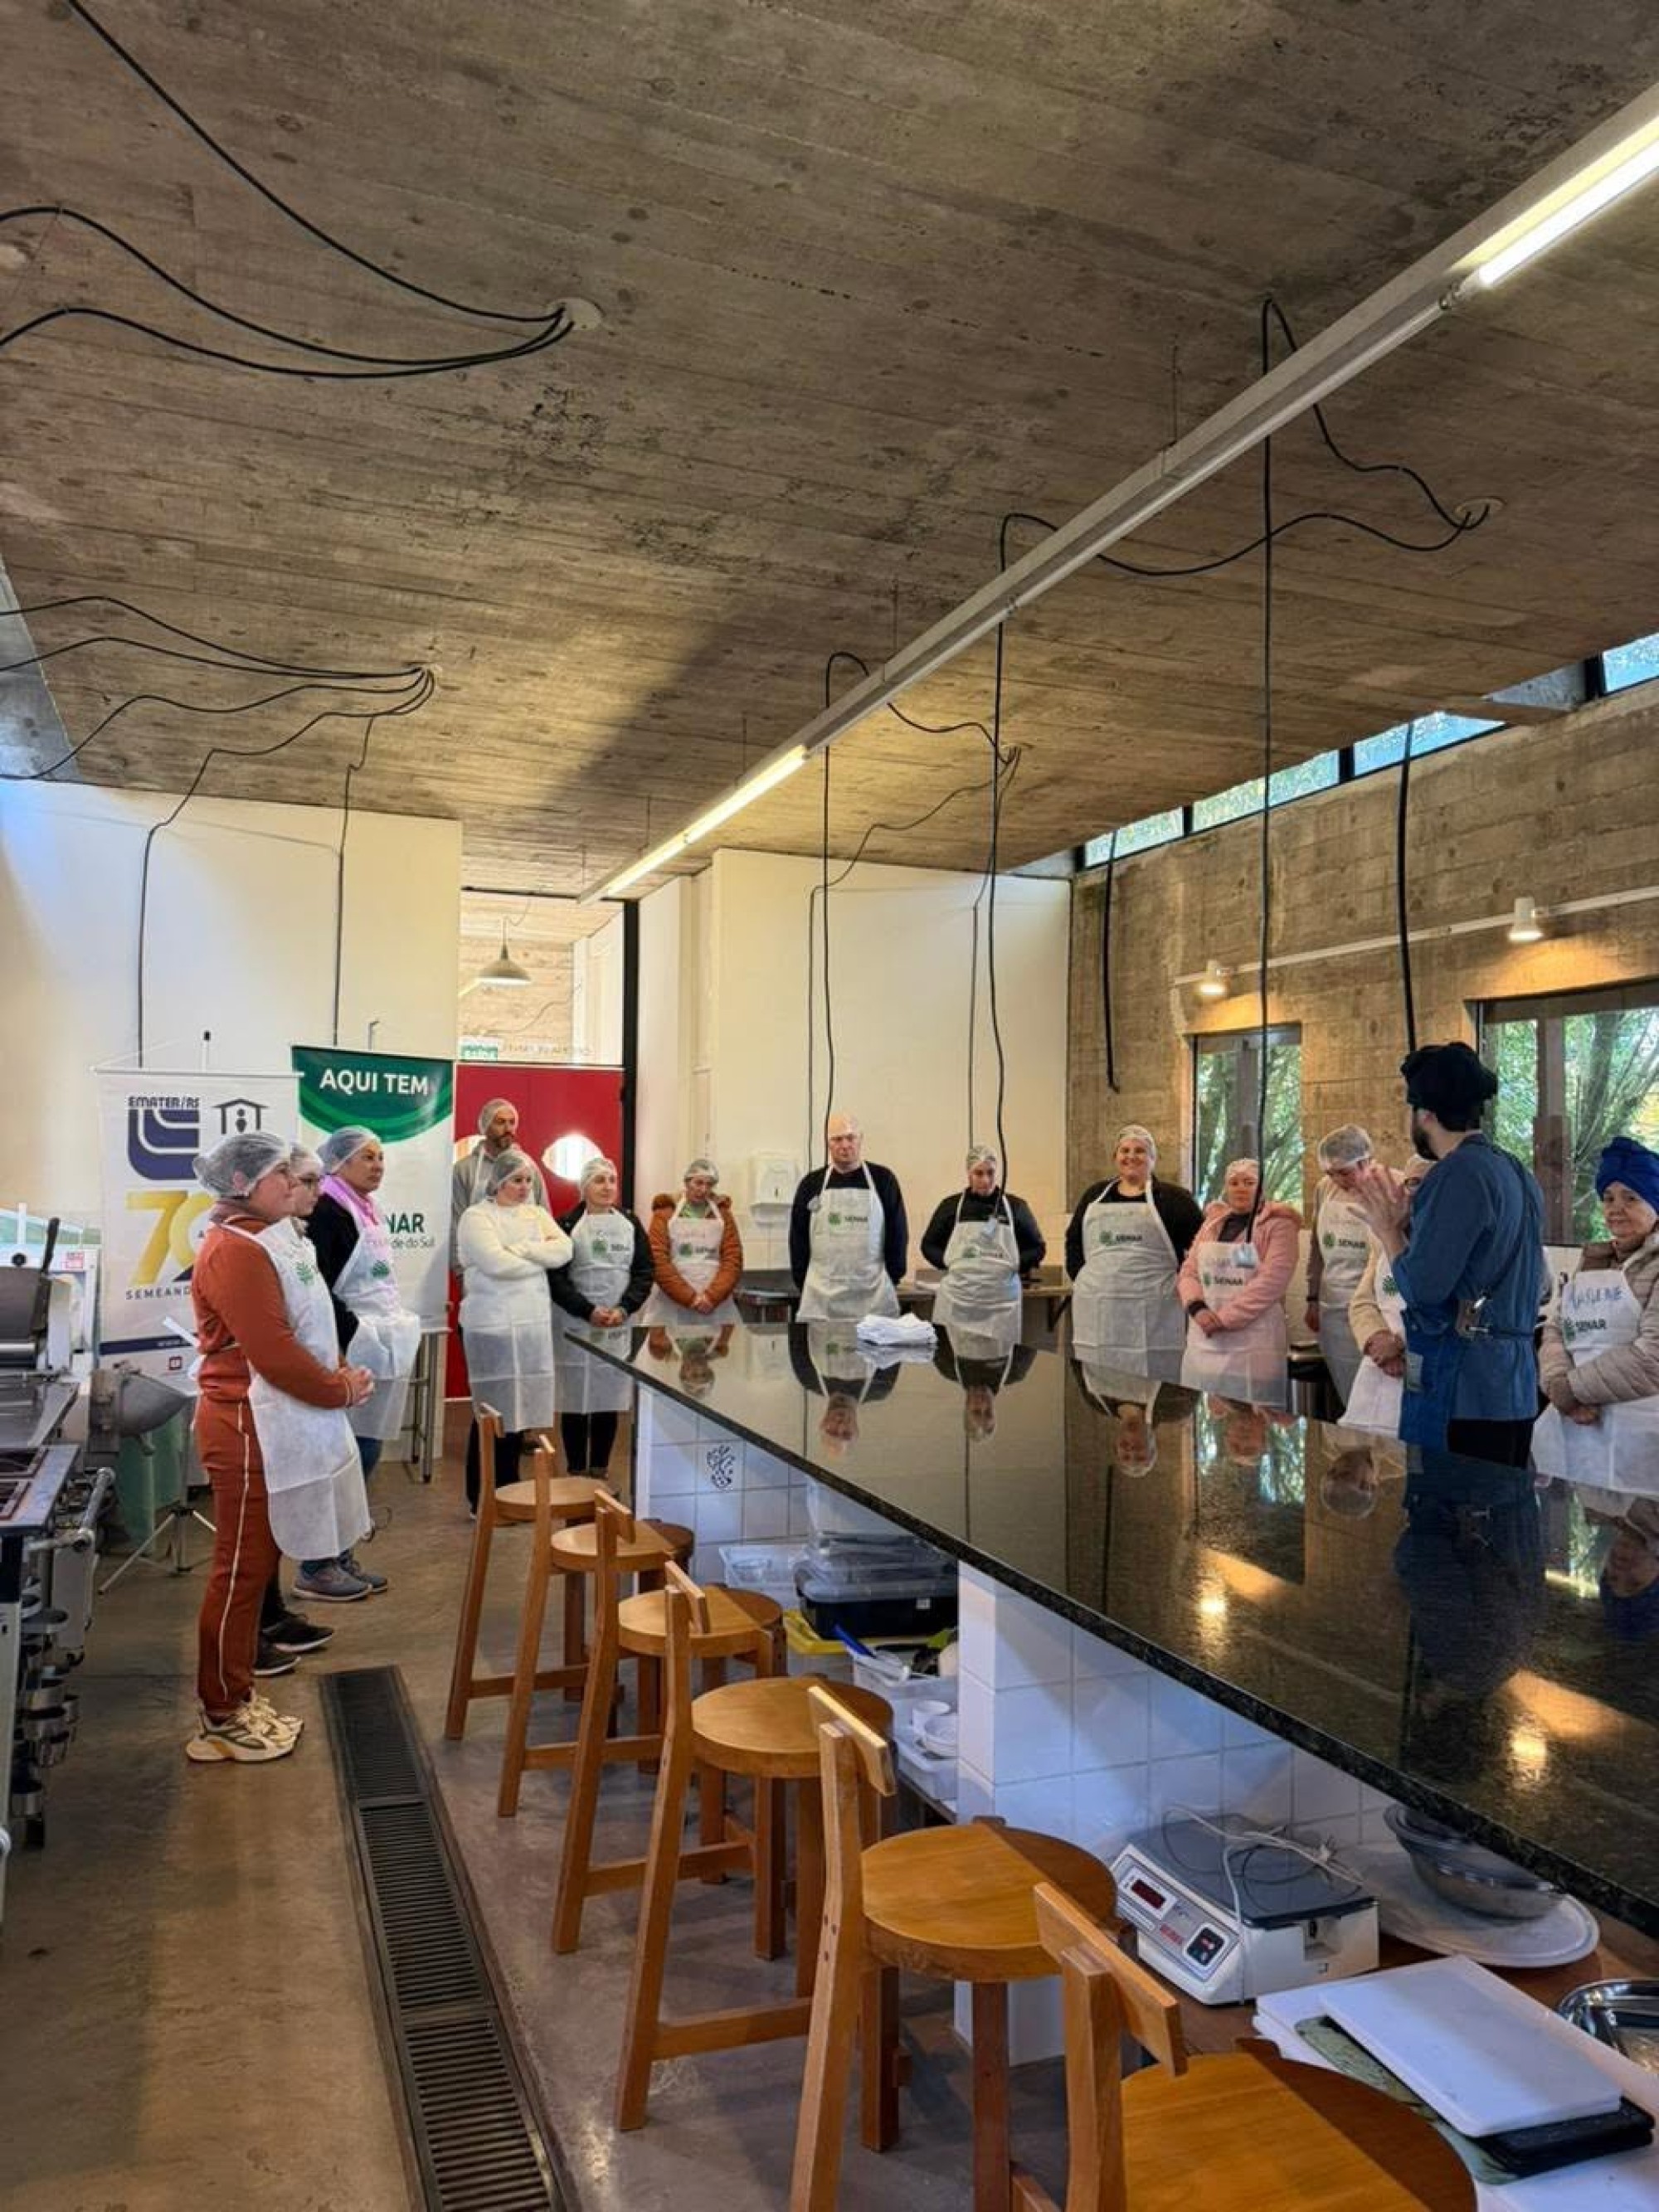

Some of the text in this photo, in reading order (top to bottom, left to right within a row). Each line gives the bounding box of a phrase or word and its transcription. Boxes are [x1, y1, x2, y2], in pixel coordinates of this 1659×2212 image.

[319, 1068, 428, 1096] AQUI TEM
[385, 1213, 424, 1234] NAR
[126, 1287, 192, 1300] SEMEAND
